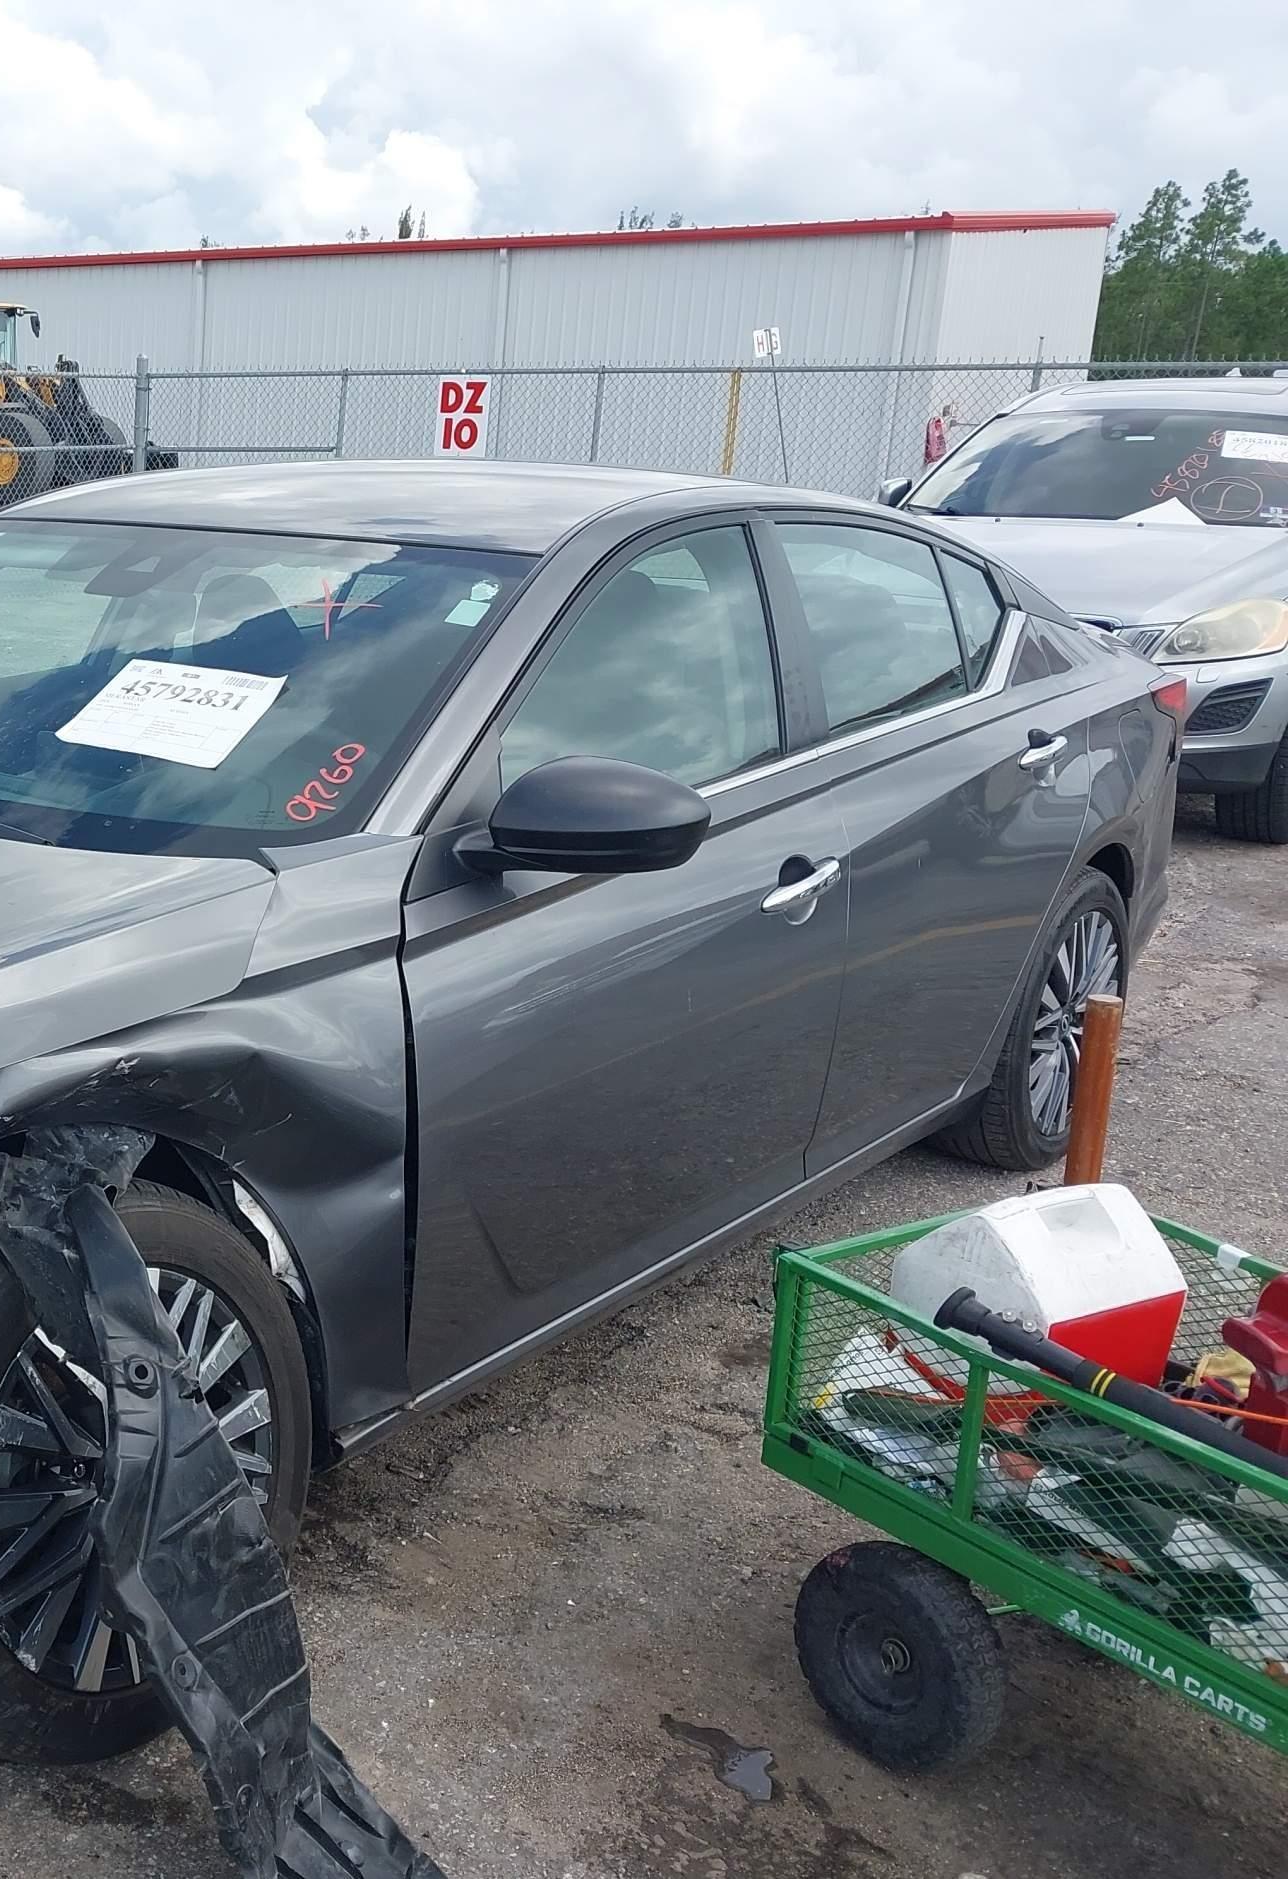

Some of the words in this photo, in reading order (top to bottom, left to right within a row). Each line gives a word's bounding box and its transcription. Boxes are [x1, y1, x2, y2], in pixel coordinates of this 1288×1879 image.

[440, 381, 488, 413] DZ
[121, 679, 250, 711] 45792831
[1086, 1621, 1177, 1687] GORILLA
[1183, 1676, 1269, 1733] CARTS
